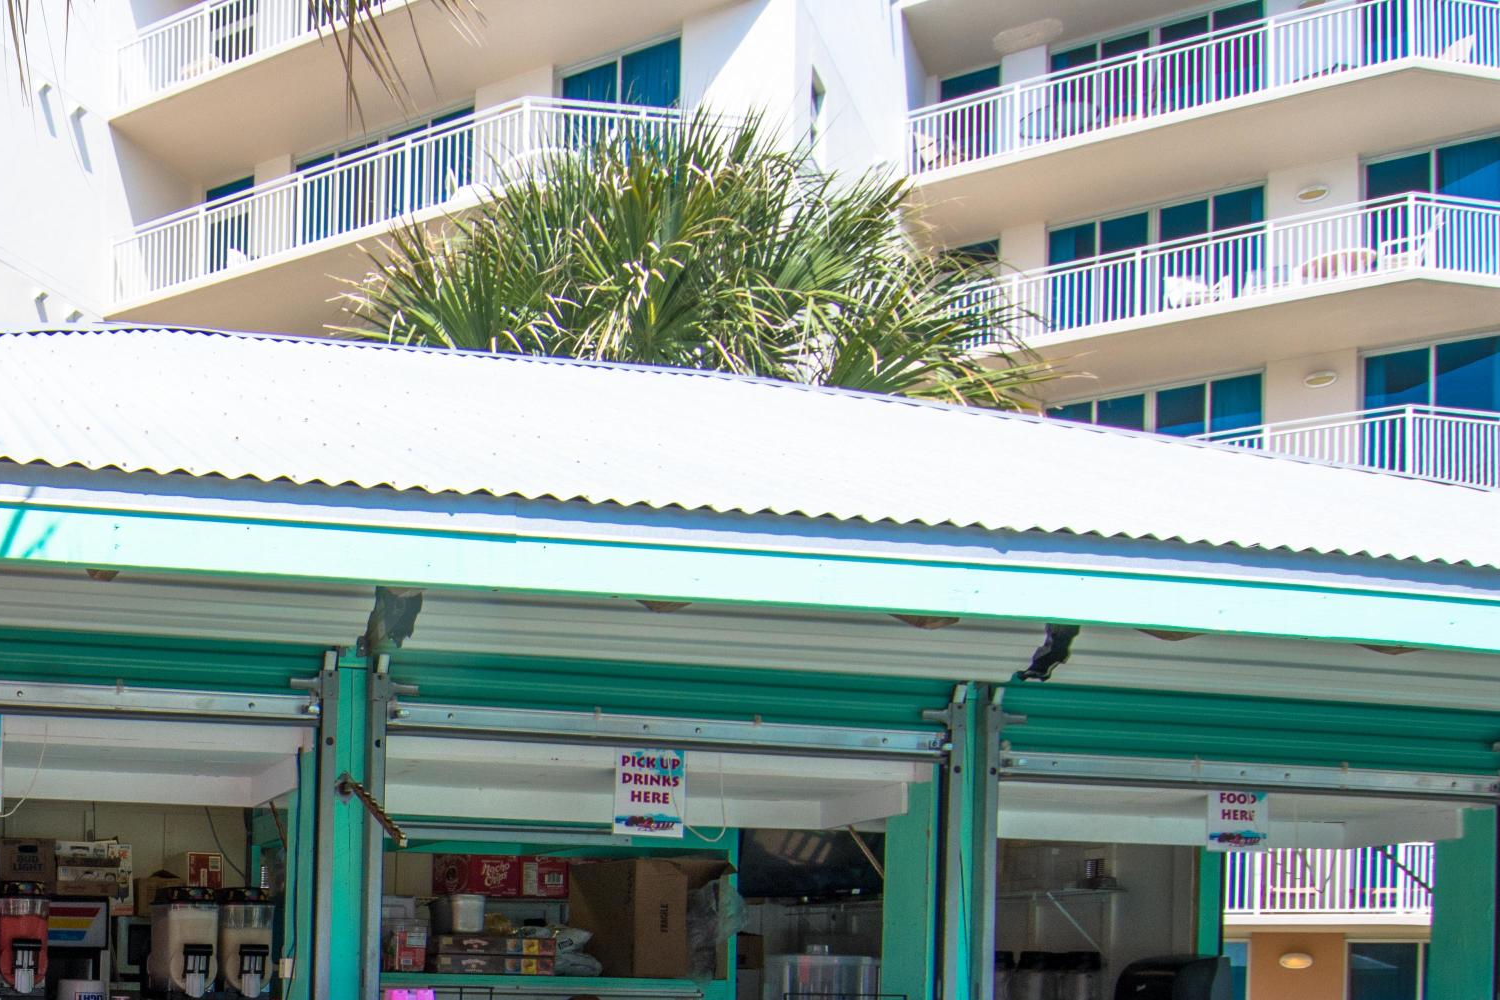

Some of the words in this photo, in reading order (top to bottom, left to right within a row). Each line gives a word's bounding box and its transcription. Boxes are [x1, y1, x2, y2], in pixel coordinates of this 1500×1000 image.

[621, 755, 656, 769] PICK
[660, 757, 680, 770] UP
[621, 772, 680, 788] DRINKS
[630, 790, 670, 805] HERE
[1220, 792, 1256, 805] FOOD
[1222, 809, 1255, 821] HERE
[481, 861, 510, 877] Nacho
